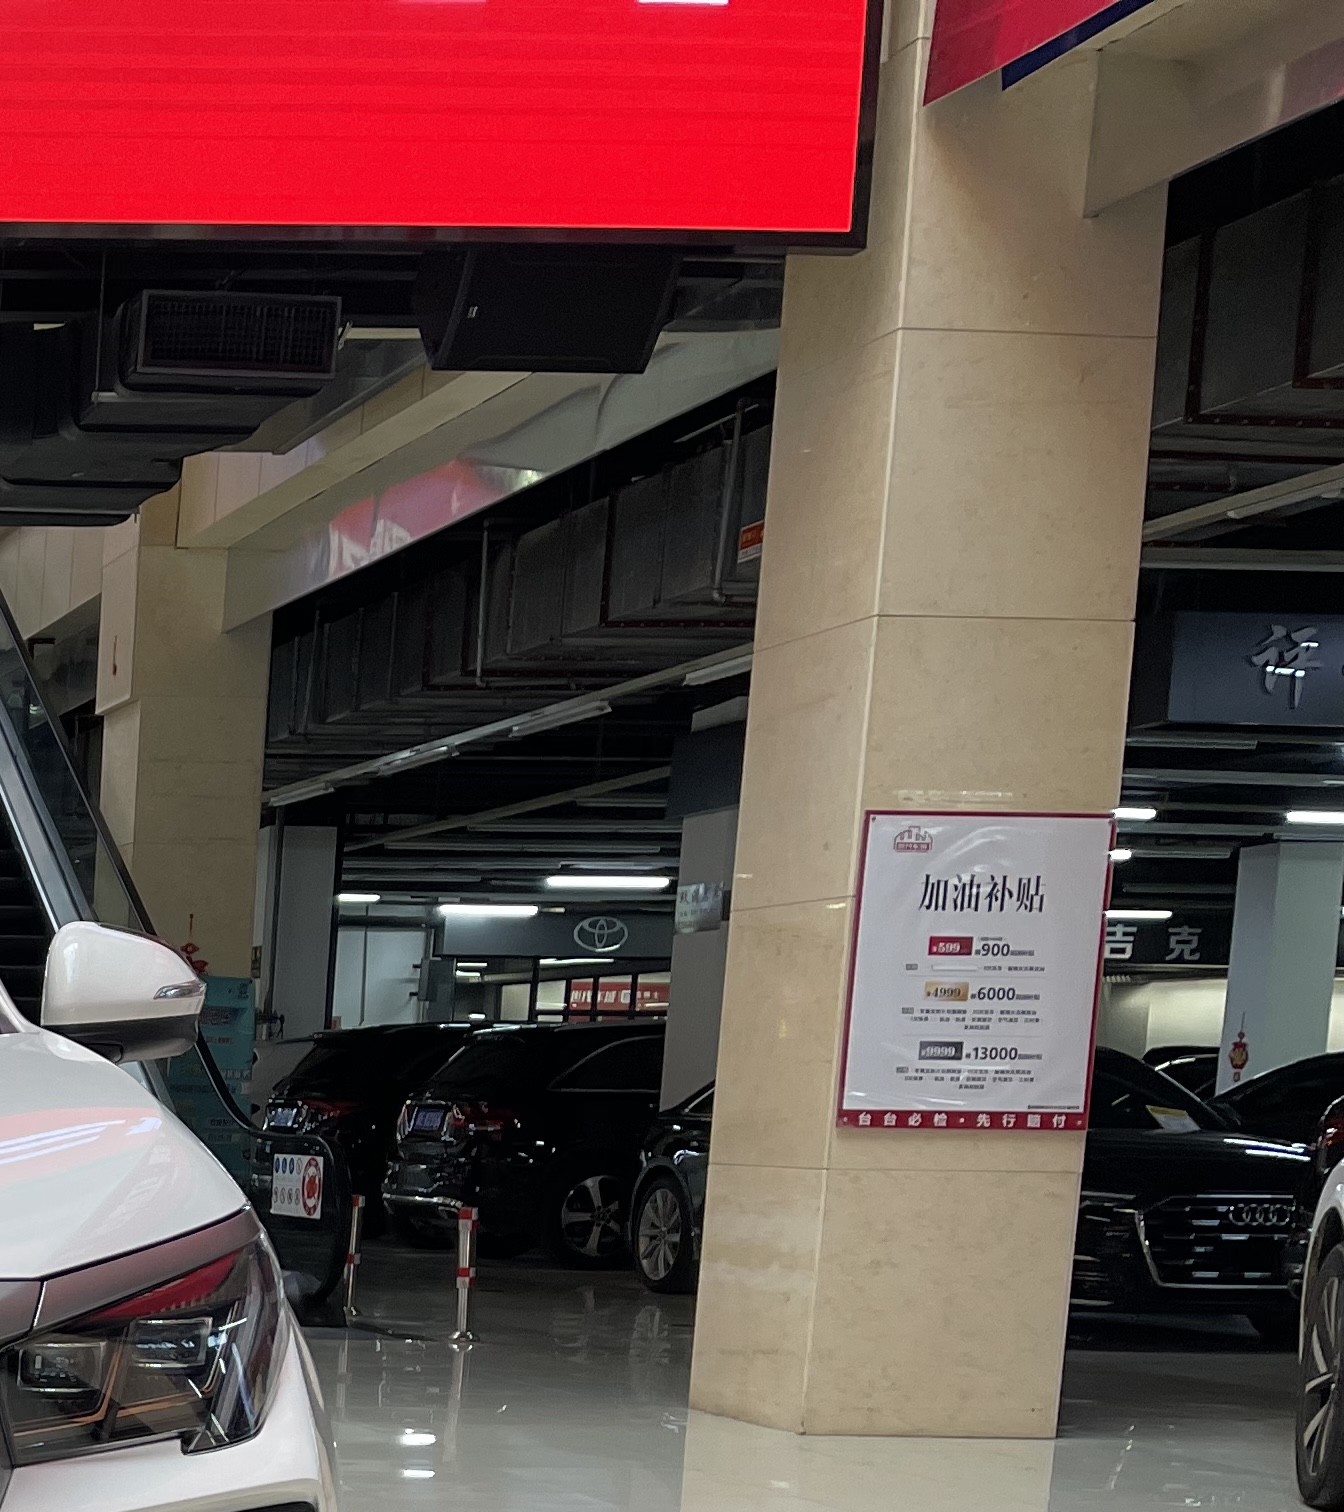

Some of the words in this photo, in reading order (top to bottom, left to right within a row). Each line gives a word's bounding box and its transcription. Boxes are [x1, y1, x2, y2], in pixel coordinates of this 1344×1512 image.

[918, 873, 1047, 913] 加油补贴
[977, 986, 1016, 1001] 6000
[972, 1046, 1018, 1061] 13000
